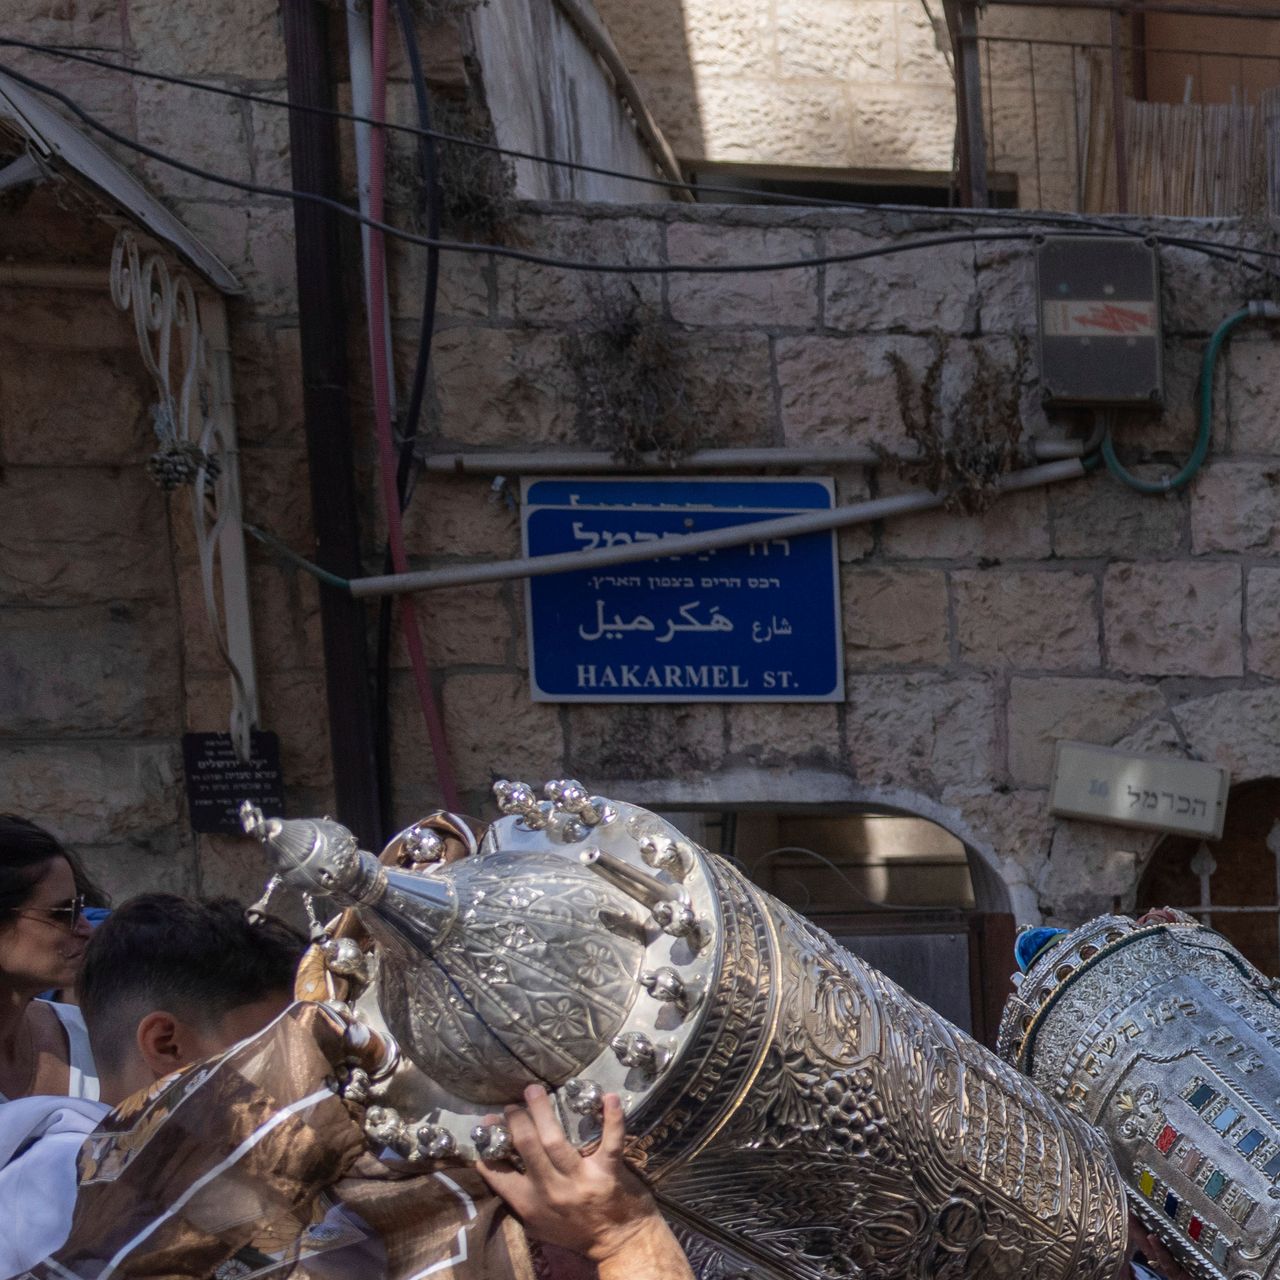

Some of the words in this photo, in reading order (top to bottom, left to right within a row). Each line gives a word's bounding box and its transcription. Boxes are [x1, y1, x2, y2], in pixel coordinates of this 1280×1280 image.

[648, 576, 694, 590] בצפון
[701, 577, 740, 588] הרים
[747, 578, 780, 589] רכס
[751, 616, 792, 643] شارع
[577, 665, 749, 688] HAKARMEL
[763, 671, 799, 688] ST.
[1127, 785, 1207, 816] הכרמל
